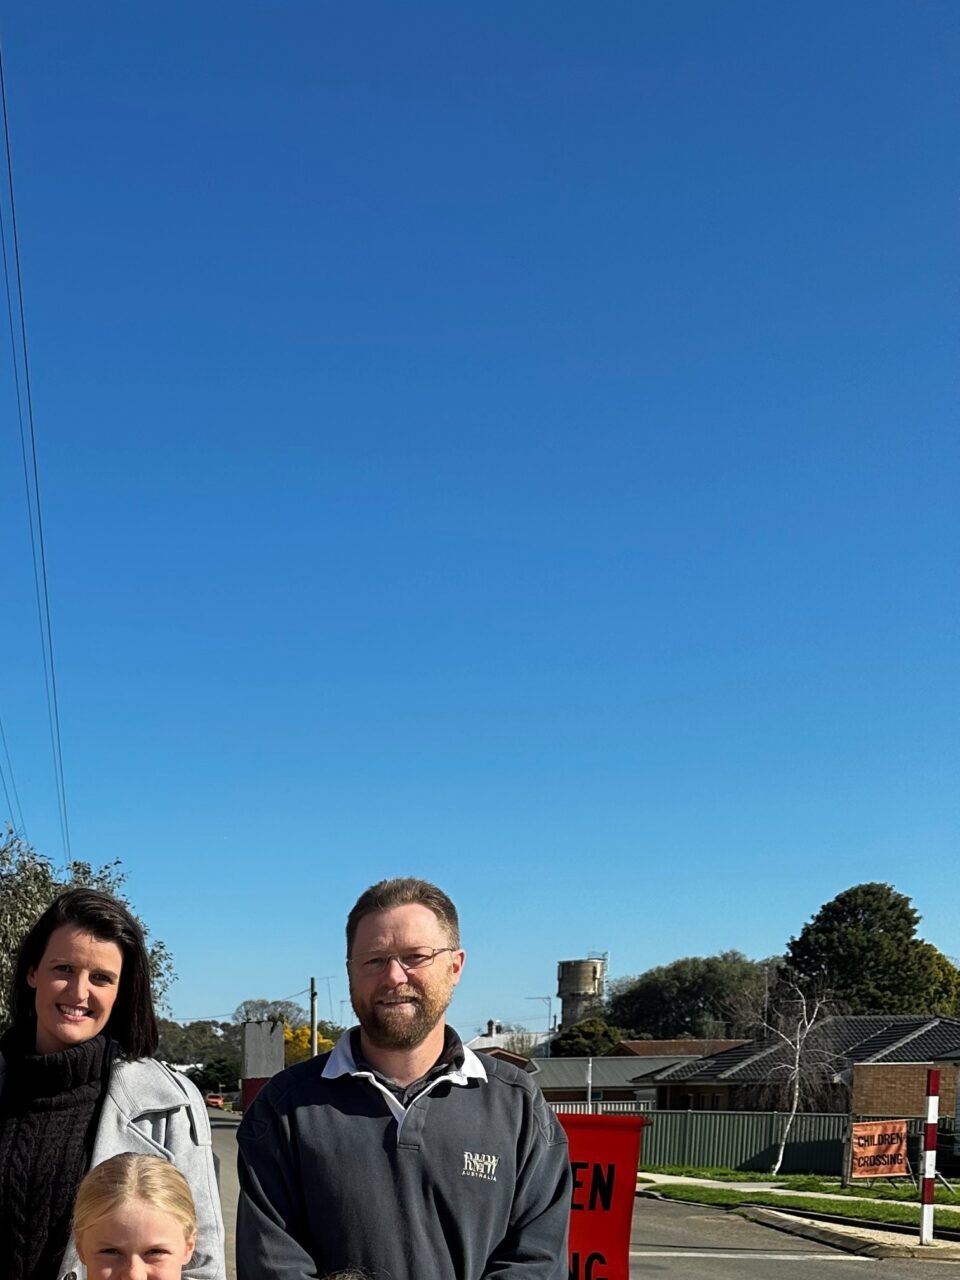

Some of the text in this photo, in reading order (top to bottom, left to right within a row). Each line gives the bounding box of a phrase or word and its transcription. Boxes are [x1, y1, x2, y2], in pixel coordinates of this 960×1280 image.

[857, 1132, 904, 1148] CHILDREN
[857, 1152, 904, 1168] CROSSING
[461, 1170, 497, 1182] AUSTRALIA
